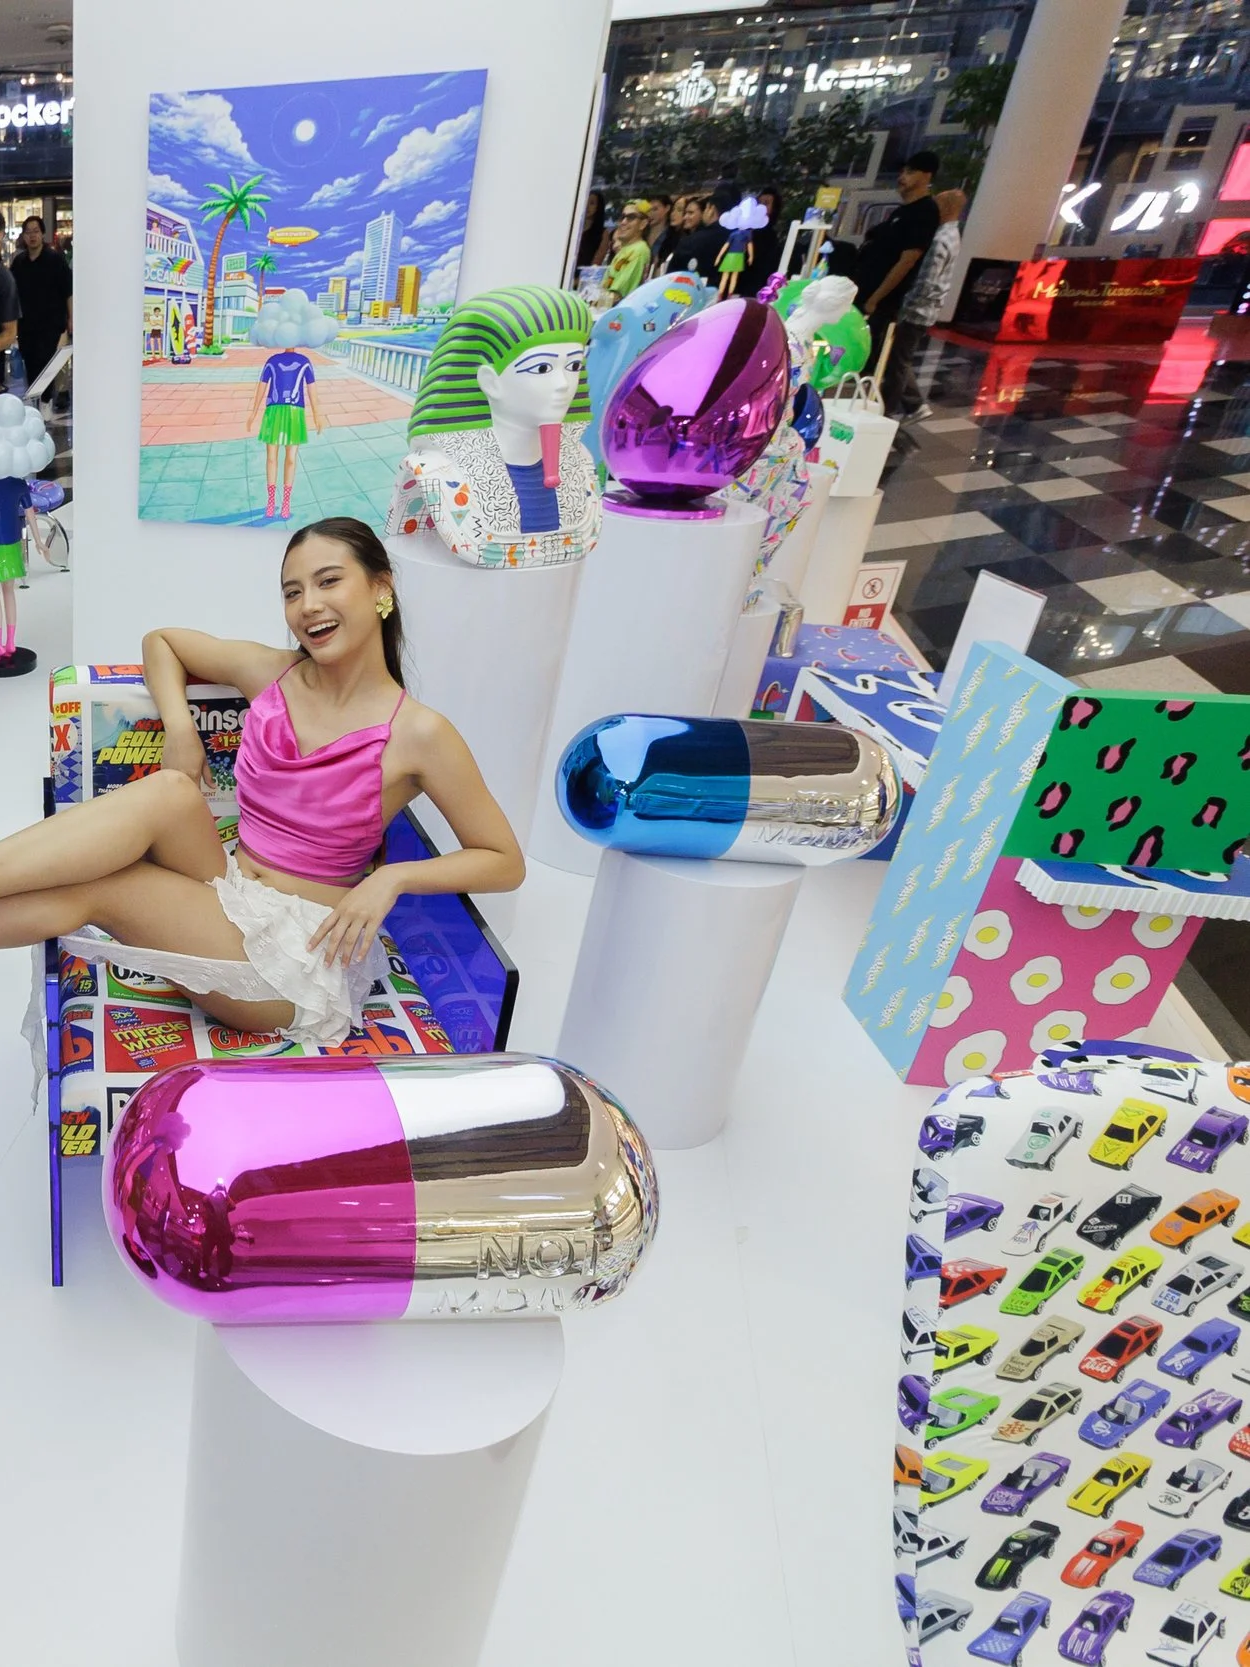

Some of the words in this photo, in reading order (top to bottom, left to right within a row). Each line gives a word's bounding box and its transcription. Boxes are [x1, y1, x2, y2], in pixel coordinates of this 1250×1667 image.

[112, 1021, 189, 1042] miracle
[121, 1033, 183, 1052] white
[476, 1231, 598, 1280] NOT
